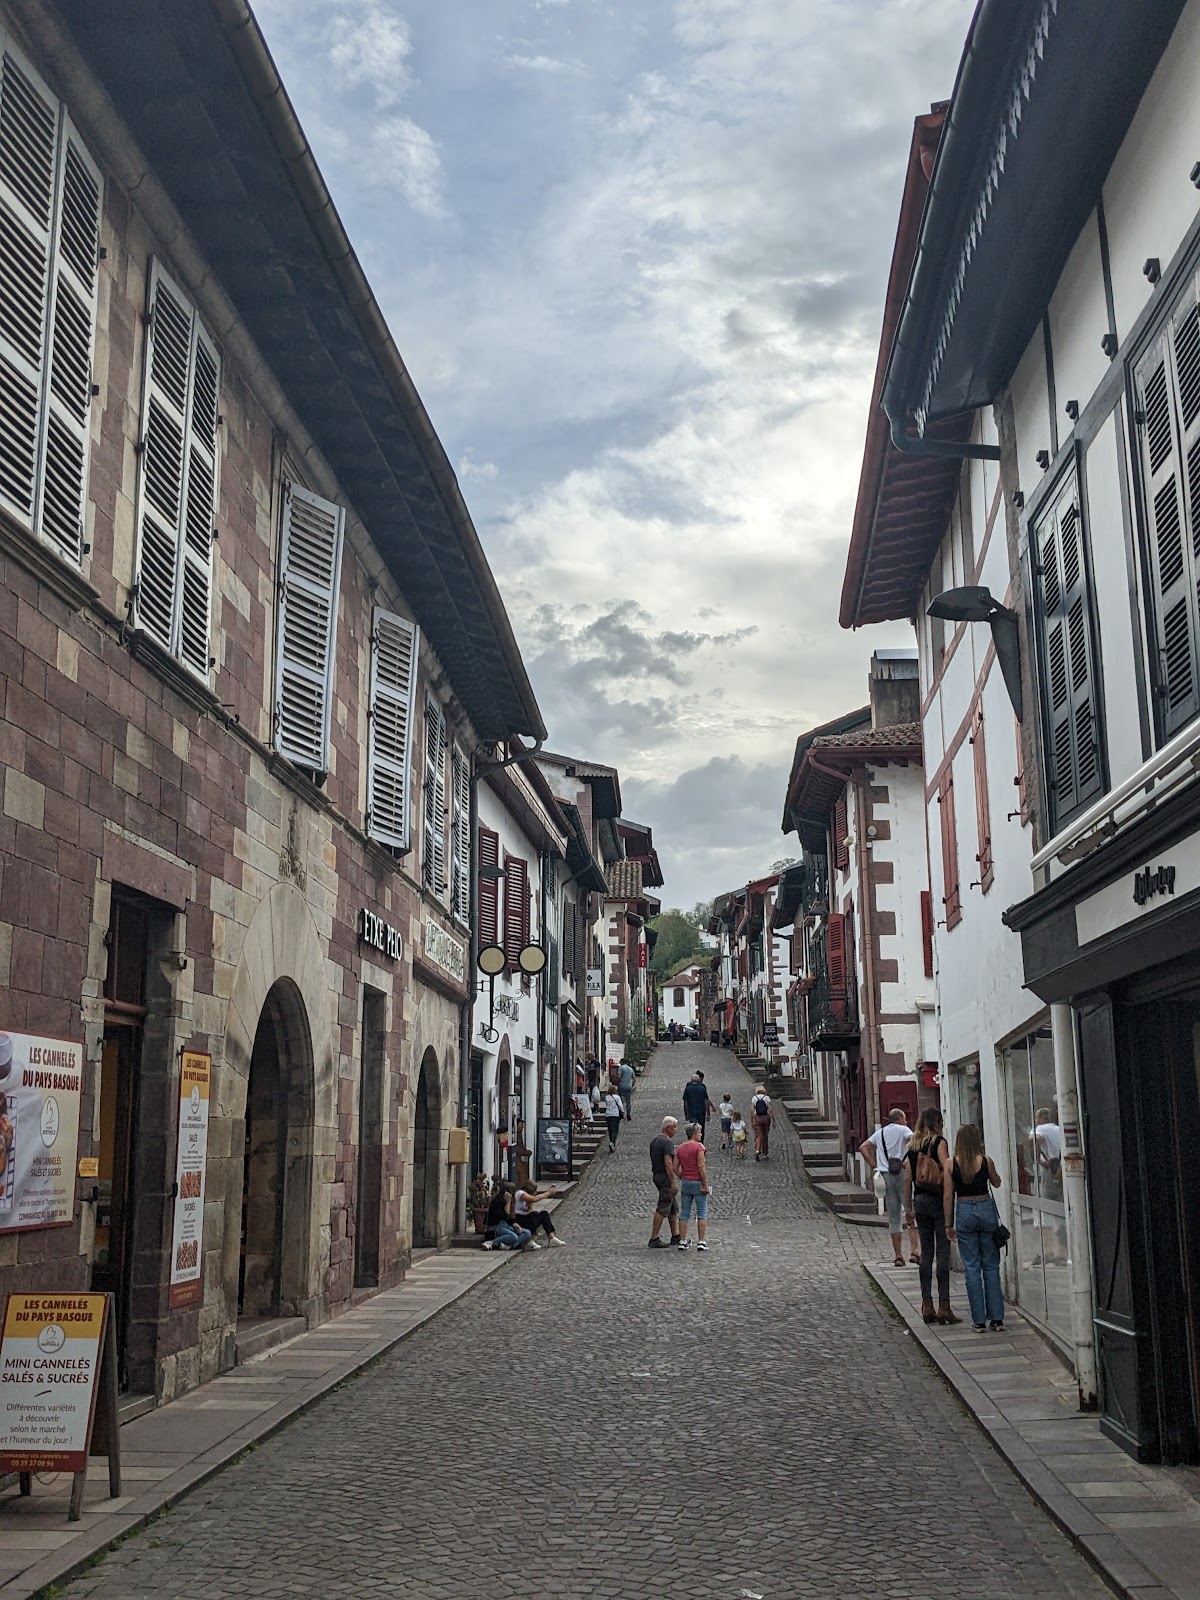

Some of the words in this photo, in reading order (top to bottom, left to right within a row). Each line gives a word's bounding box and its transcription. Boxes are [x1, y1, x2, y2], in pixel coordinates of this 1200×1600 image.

[363, 908, 384, 950] ETXE
[387, 924, 402, 960] PEIO
[29, 1046, 42, 1064] LES
[43, 1048, 76, 1068] CANNELÉS
[22, 1069, 34, 1088] DU
[34, 1070, 52, 1090] PAYS
[53, 1072, 80, 1092] BASQUE
[24, 1300, 40, 1310] LES
[41, 1298, 88, 1310] CANNELÉS
[15, 1312, 30, 1322] DU
[31, 1312, 54, 1322] PAYS
[56, 1312, 94, 1322] BASQUE
[5, 1358, 30, 1368] MINI
[33, 1357, 90, 1368] CANNELÉS
[2, 1371, 34, 1382] SALÉS
[36, 1373, 44, 1384] &
[47, 1372, 90, 1384] SUCRÉS
[6, 1402, 46, 1412] Différentes
[47, 1403, 76, 1412] variétés
[25, 1414, 60, 1422] découvrir
[39, 1425, 66, 1434] marché
[52, 1437, 68, 1446] jour
